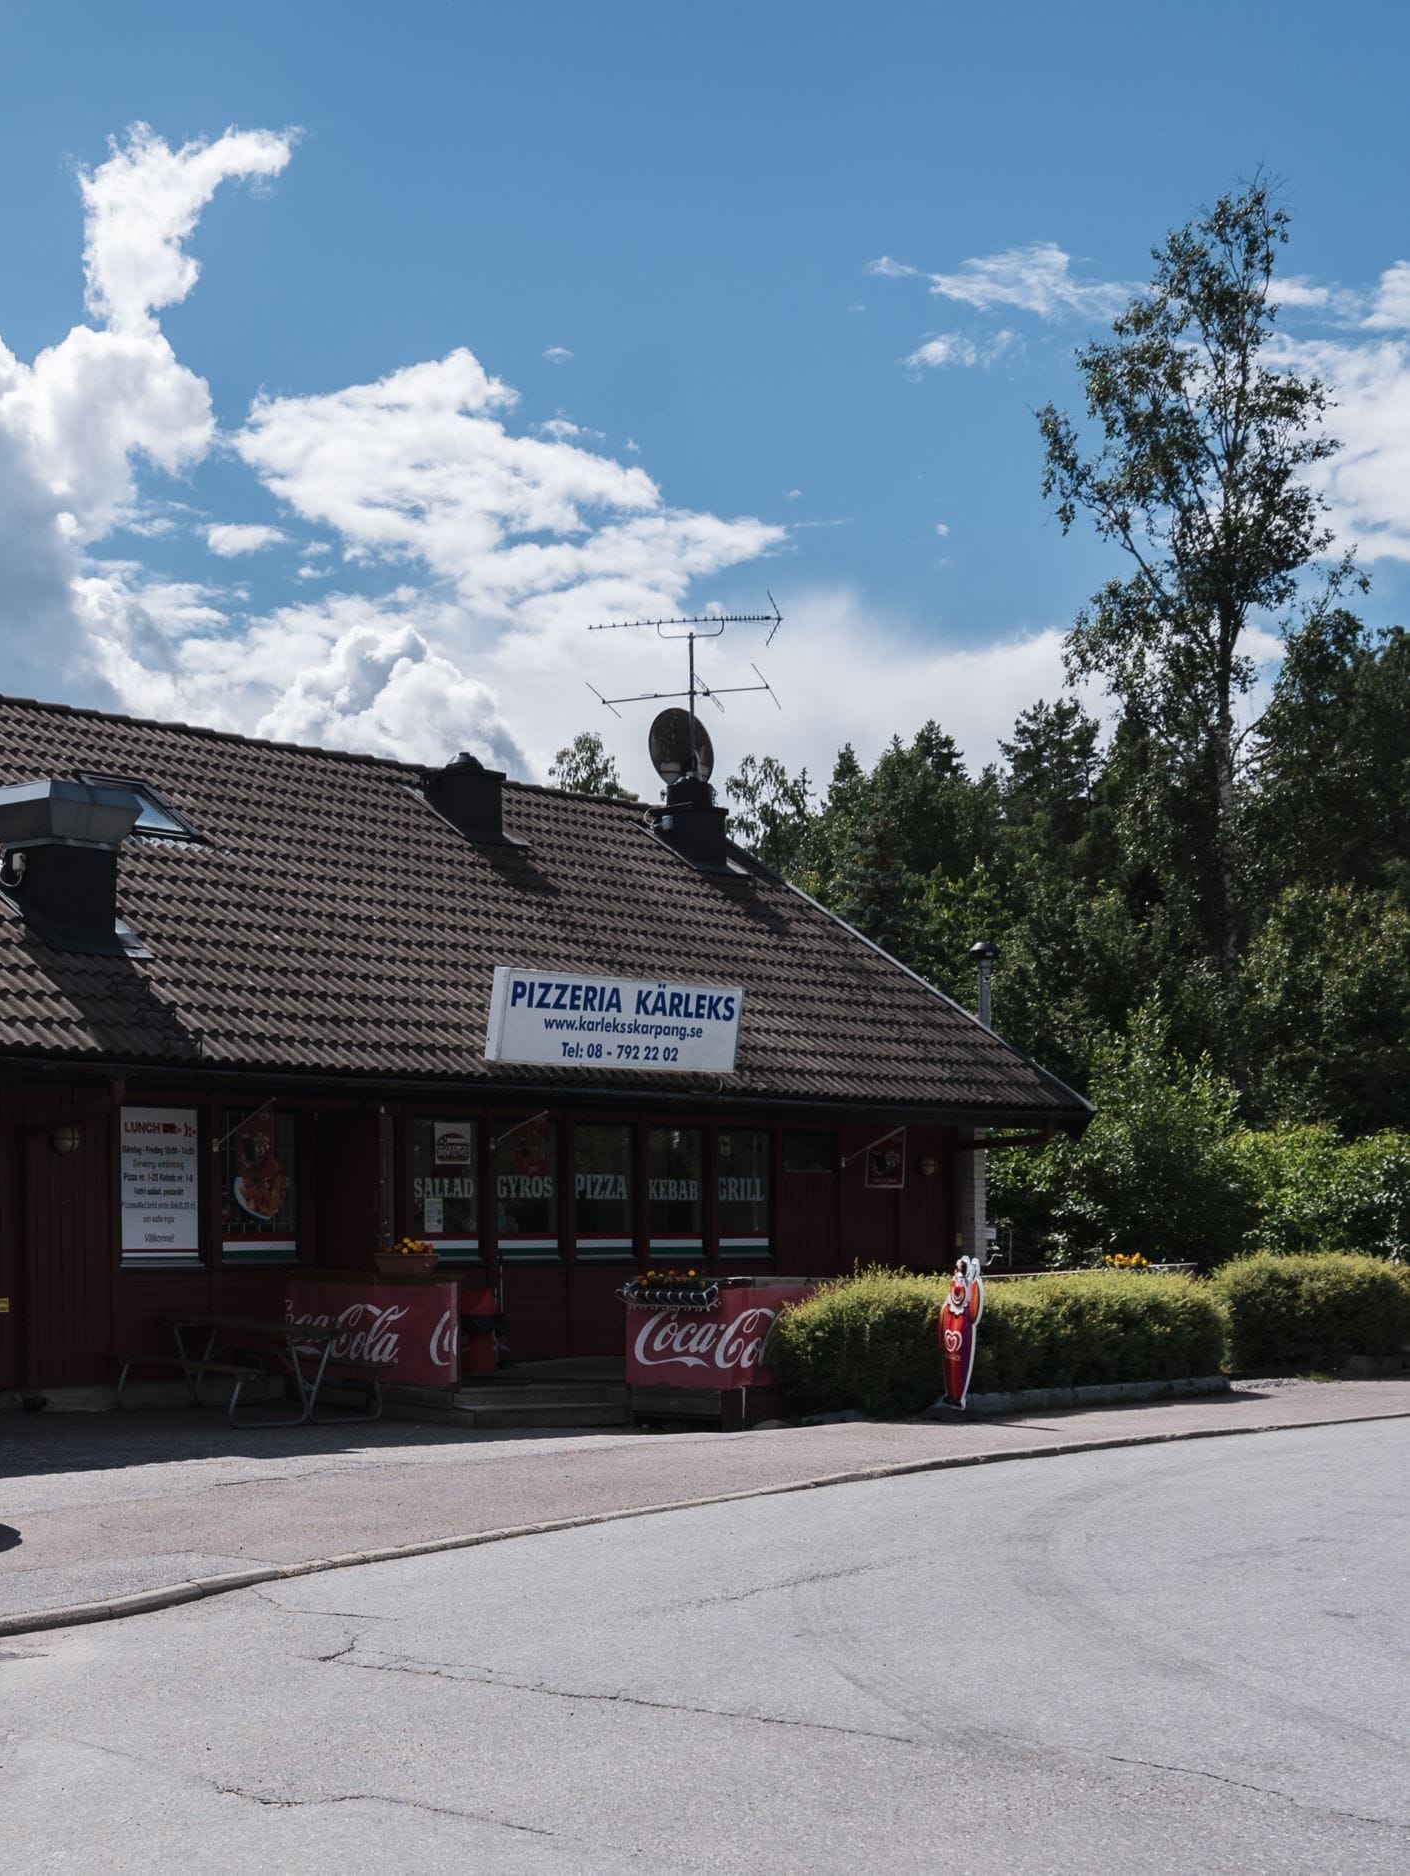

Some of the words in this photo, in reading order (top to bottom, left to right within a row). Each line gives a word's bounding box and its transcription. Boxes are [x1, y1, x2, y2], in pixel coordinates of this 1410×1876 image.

[510, 980, 622, 1013] PIZZERIA
[635, 984, 735, 1021] KÄRLEKS
[544, 1016, 703, 1040] www.karleksskarpang.se
[561, 1042, 583, 1058] Tel:
[586, 1043, 603, 1058] 08
[616, 1045, 640, 1060] 792
[643, 1046, 659, 1061] 22
[662, 1047, 679, 1062] 02
[124, 1121, 160, 1134] LUNCH
[123, 1173, 138, 1181] Pizza
[159, 1174, 176, 1182] Kebab
[414, 1177, 474, 1198] SALLAD
[497, 1175, 554, 1199] GYROS
[575, 1174, 628, 1200] PIZZA
[649, 1179, 699, 1200] KEBAB
[718, 1176, 765, 1201] GRILL
[634, 1308, 785, 1369] Coca-Col
